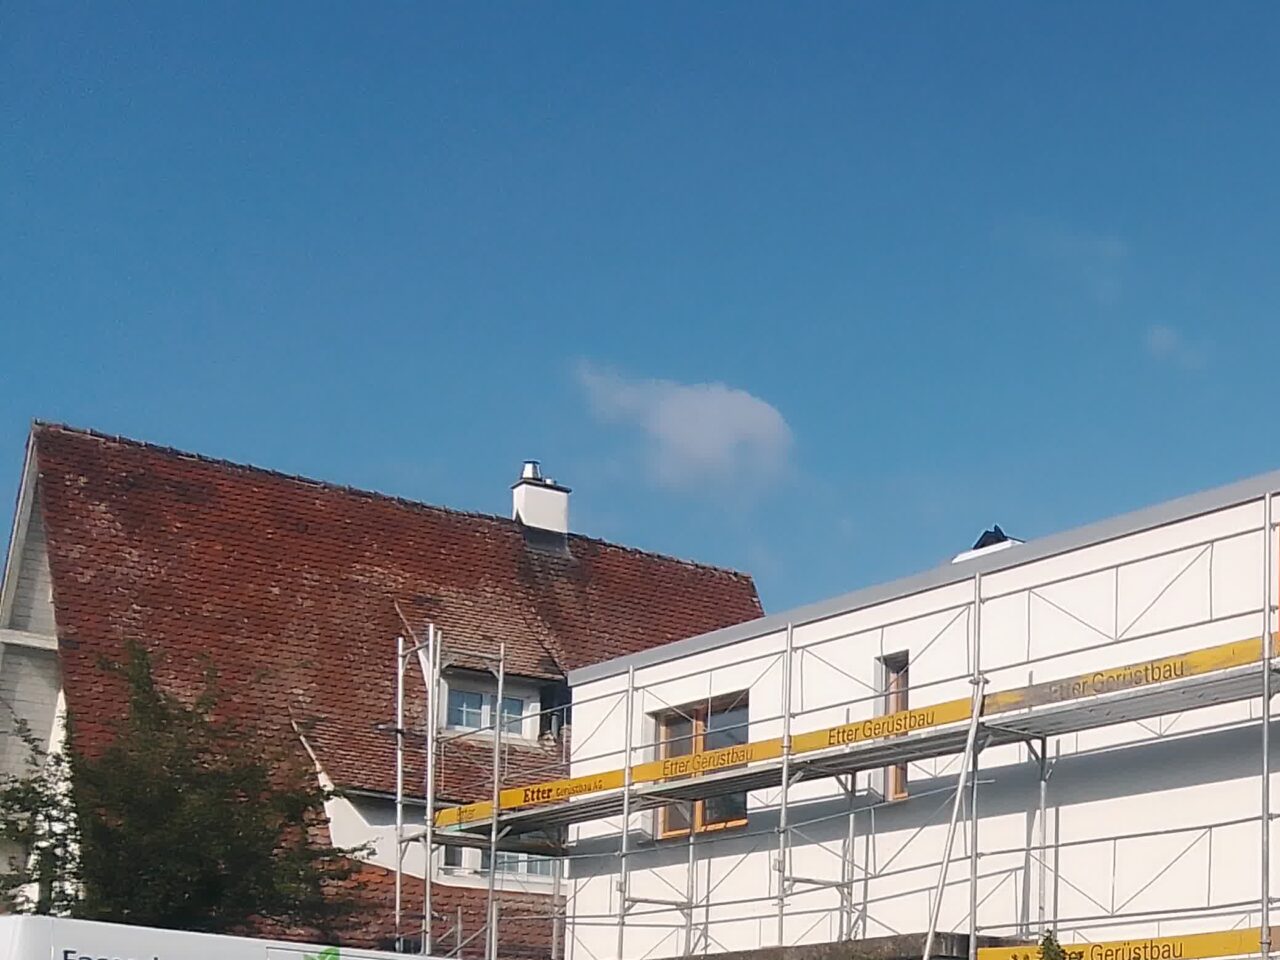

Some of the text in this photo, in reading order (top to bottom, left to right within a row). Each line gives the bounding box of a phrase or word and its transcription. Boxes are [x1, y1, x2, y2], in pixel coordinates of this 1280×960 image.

[1092, 660, 1185, 693] Gerüstbau
[828, 709, 935, 746] Etter Gerüstbau
[662, 747, 754, 776] Etter Gerüstbau
[523, 787, 553, 803] Etter
